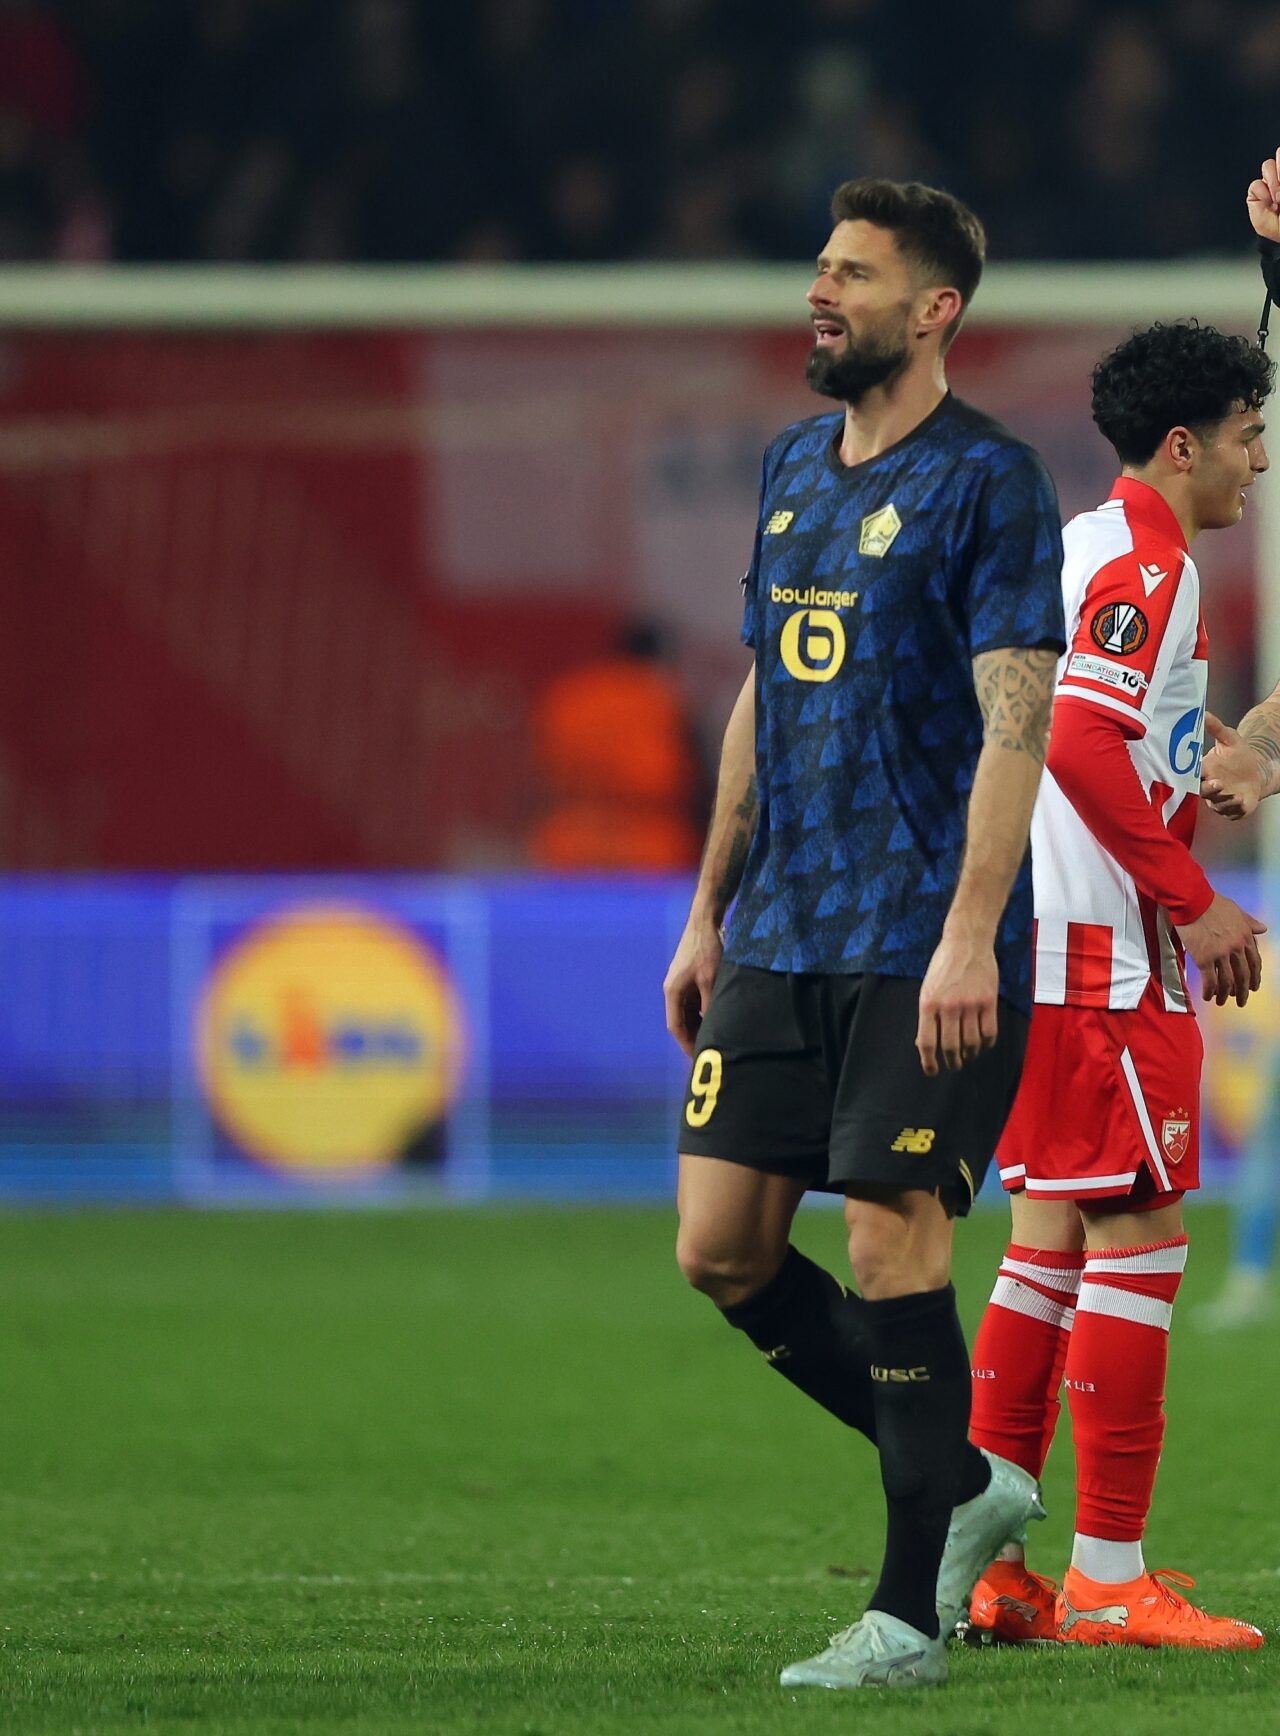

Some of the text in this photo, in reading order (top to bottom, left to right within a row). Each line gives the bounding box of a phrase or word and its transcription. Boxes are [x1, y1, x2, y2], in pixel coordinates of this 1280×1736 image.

[771, 584, 858, 609] boulanger
[1072, 660, 1120, 678] FOUNDATION
[686, 1049, 722, 1128] 9
